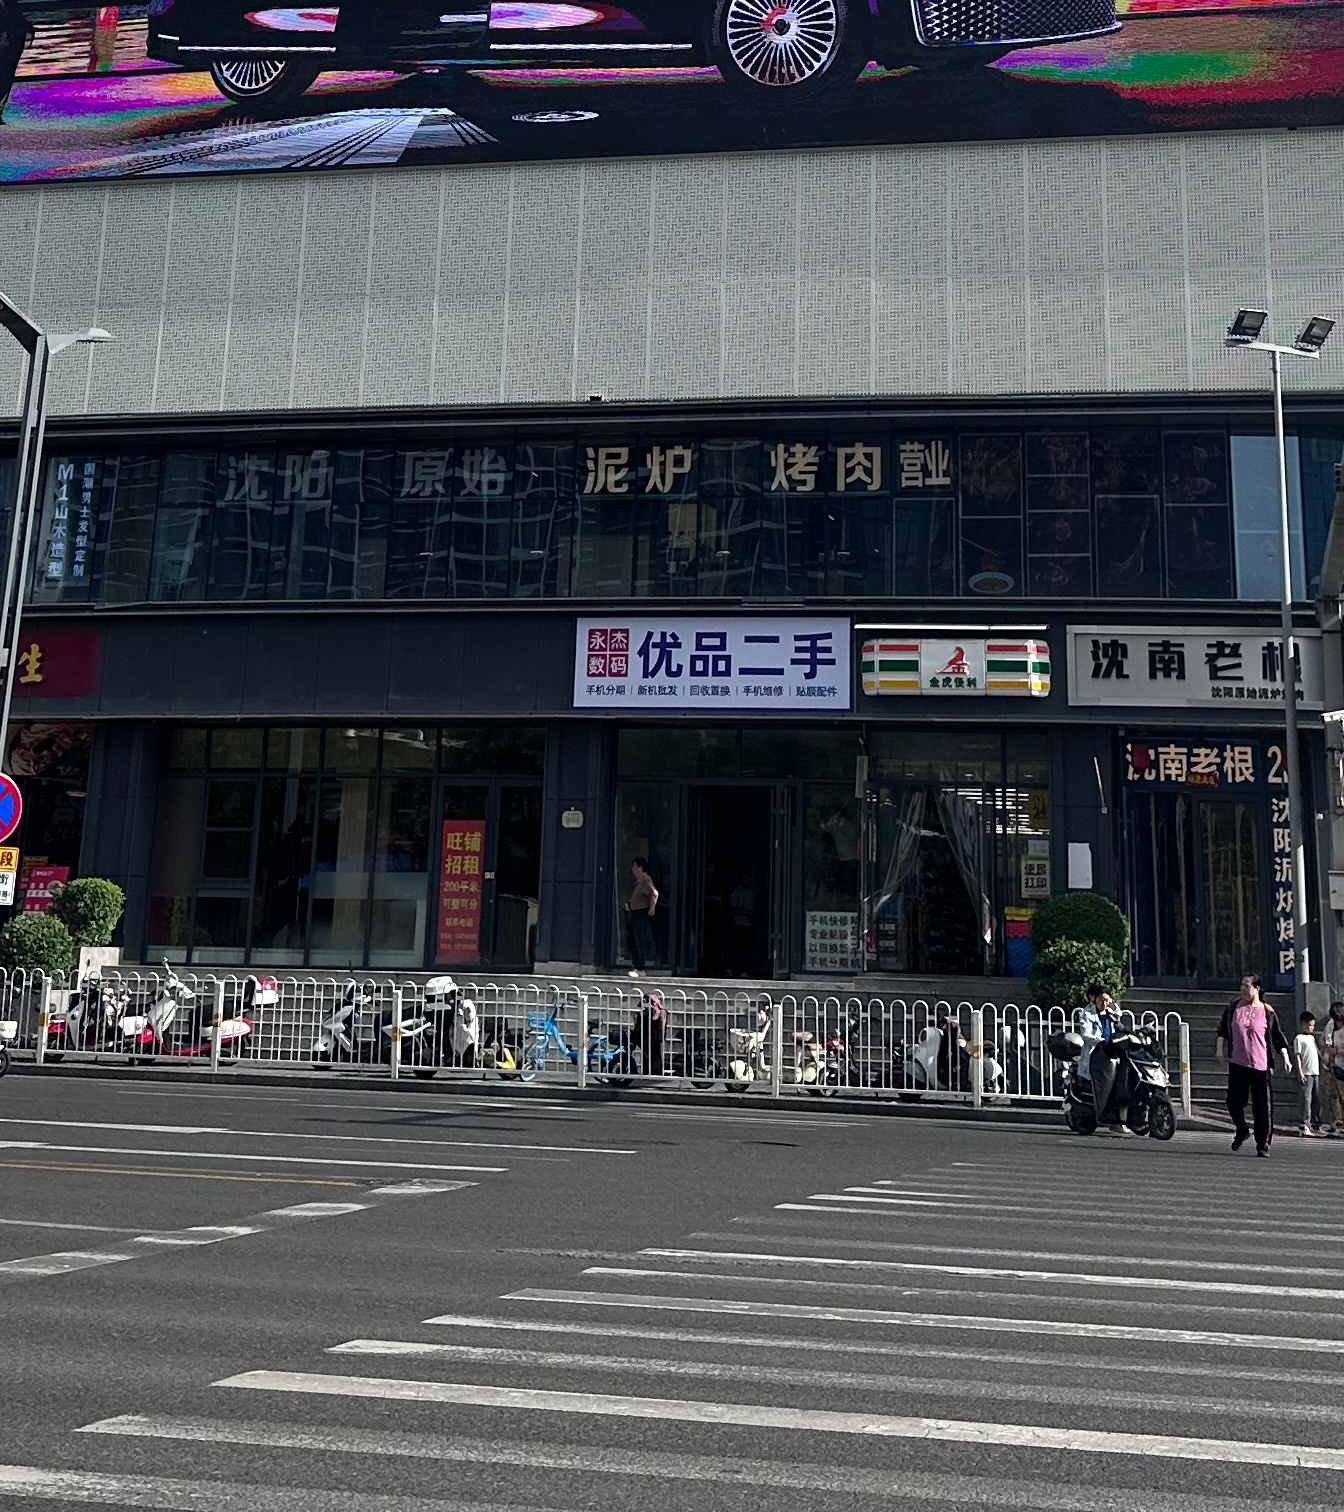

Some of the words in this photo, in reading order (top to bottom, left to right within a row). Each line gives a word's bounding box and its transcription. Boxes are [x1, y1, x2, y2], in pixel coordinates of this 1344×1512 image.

[582, 445, 694, 494] 泥炉
[770, 442, 882, 492] 烤肉
[898, 440, 952, 489] 营业
[588, 629, 629, 651] 永杰
[587, 655, 629, 676] 数码
[636, 630, 837, 680] 优品二手
[585, 684, 626, 696] 手机分期
[929, 676, 977, 688] 金虎便利
[446, 831, 482, 852] 旺铺
[445, 854, 480, 875] 招租
